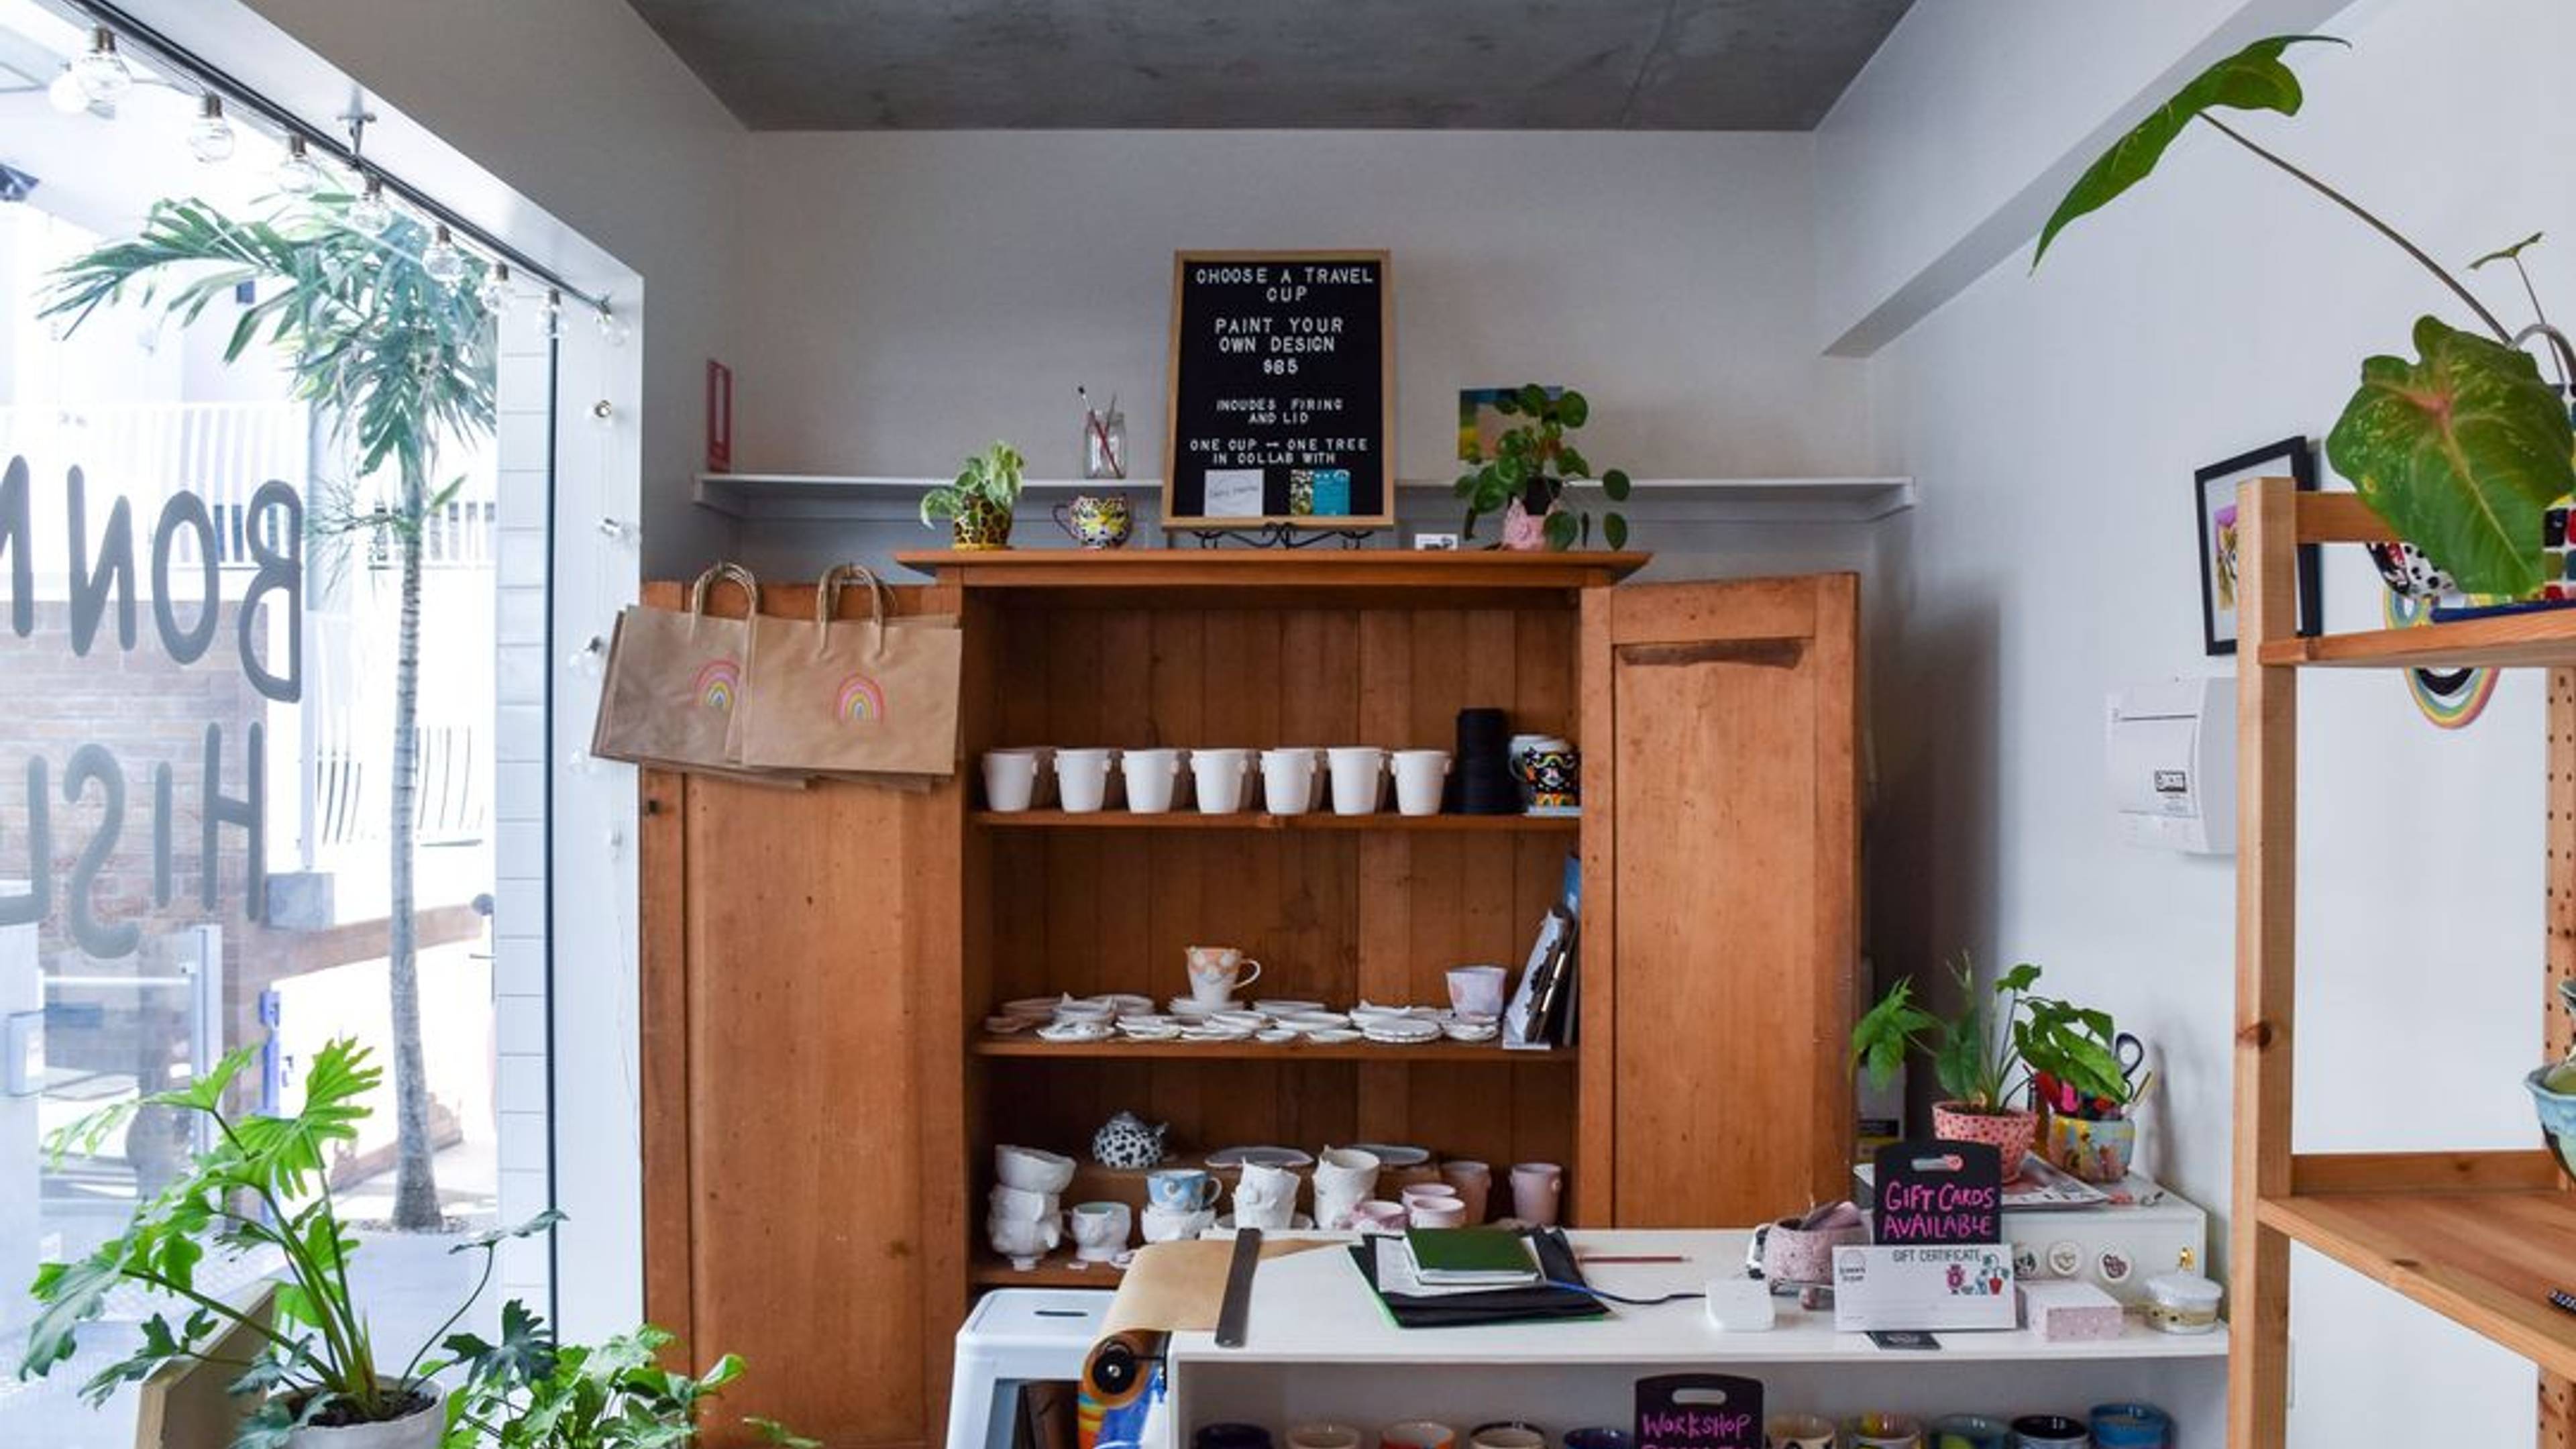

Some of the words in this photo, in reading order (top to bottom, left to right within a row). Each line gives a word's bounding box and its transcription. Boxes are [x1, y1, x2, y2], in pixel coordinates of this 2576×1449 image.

[1196, 268, 1268, 284] CHOOSE
[1280, 270, 1292, 284] A
[1305, 268, 1374, 284] TRAVEL
[1266, 286, 1307, 302] CUP
[1214, 317, 1273, 334] PAINT
[1289, 317, 1344, 333] YOUR
[1219, 337, 1256, 353] OWN
[1270, 337, 1336, 352] DESIGN
[1289, 398, 1344, 411] FIRING
[1248, 412, 1277, 425] AND
[1282, 412, 1309, 424] LID
[1189, 439, 1220, 451] ONE
[1228, 439, 1258, 451] CUP
[1287, 439, 1318, 451] ONE
[1326, 438, 1368, 451] TREE
[1213, 453, 1228, 465] IN
[1238, 453, 1294, 464] COLLAB
[1303, 453, 1336, 465] WITH
[1886, 1181, 1935, 1212] GIFT
[1938, 1182, 1995, 1212] CARDS
[1883, 1213, 1993, 1240] AVAILABLE
[1892, 1249, 1915, 1262] GIFT
[1920, 1249, 1981, 1262] CERTIFICATE
[1644, 1411, 1752, 1439] WORKSHOP
